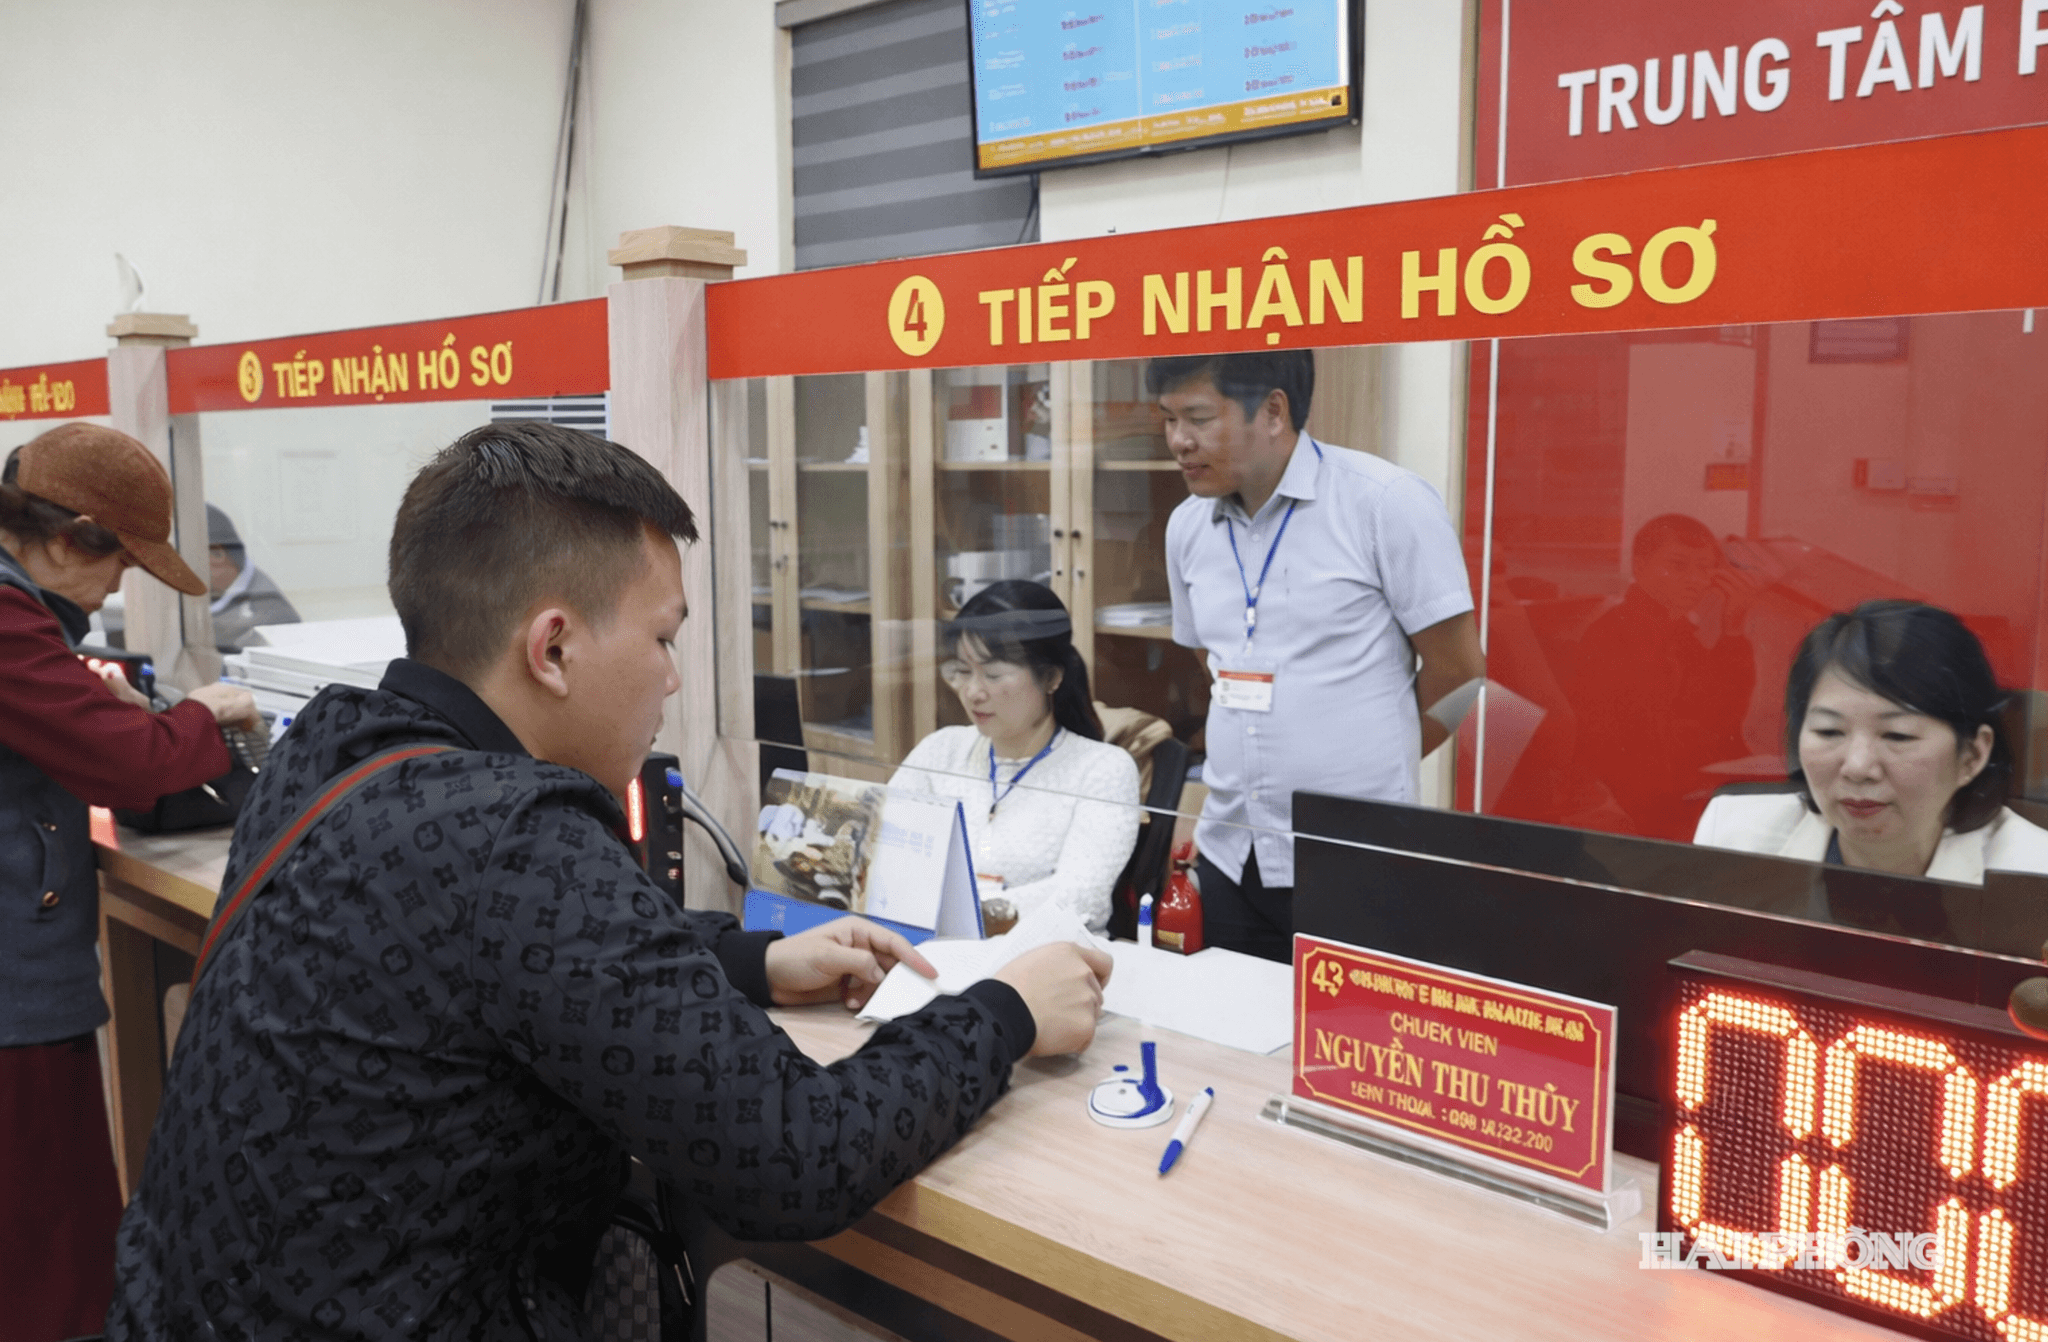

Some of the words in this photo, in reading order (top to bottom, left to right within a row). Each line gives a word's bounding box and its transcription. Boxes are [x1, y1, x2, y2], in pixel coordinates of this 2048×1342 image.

[1558, 38, 1790, 136] TRUNG
[1817, 0, 1984, 101] TÂM
[978, 257, 1116, 346] TIẾP
[1143, 246, 1367, 346] NHẬN
[1402, 213, 1531, 319] HỒ
[1571, 219, 1717, 308] SƠ
[272, 349, 325, 398] TIẾP
[332, 345, 409, 401] NHẬN
[470, 341, 513, 387] SƠ
[1431, 1060, 1491, 1107] THU
